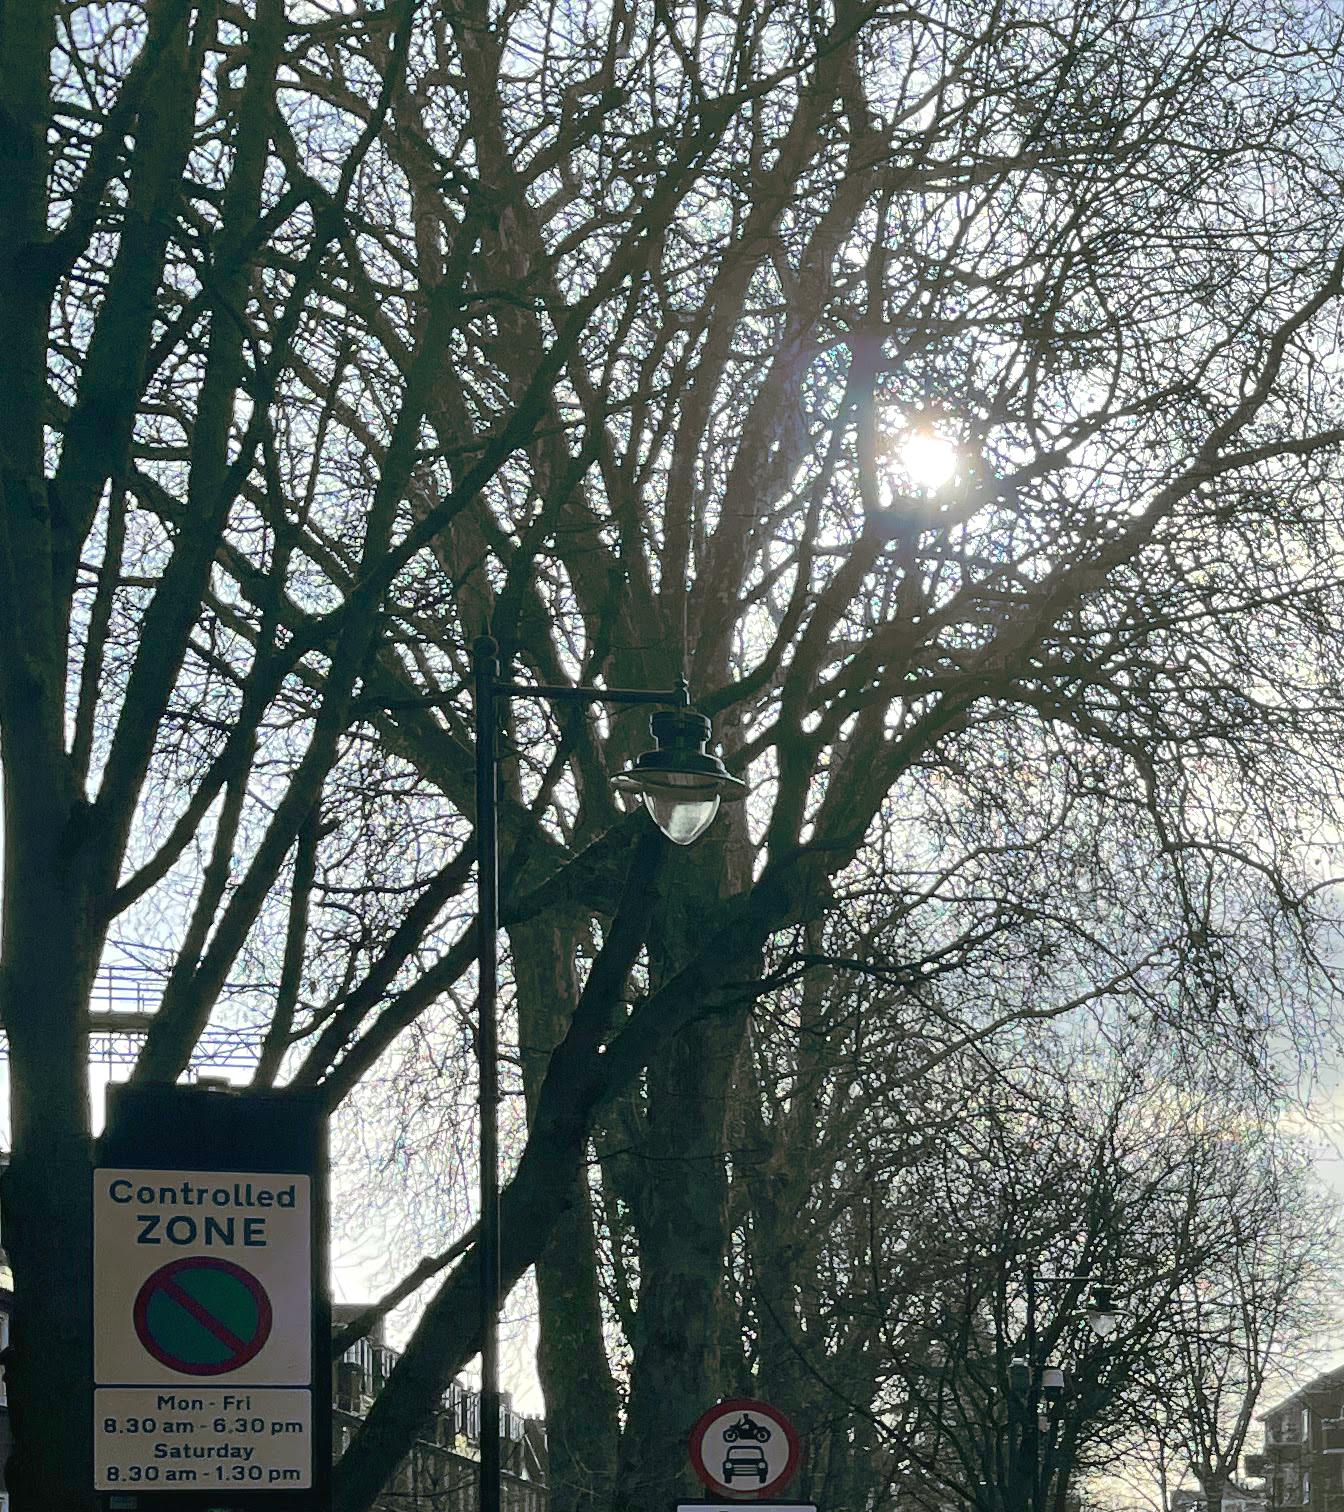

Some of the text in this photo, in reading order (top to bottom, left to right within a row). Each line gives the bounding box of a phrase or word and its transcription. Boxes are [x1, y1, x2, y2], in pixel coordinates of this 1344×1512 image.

[109, 1179, 296, 1208] Controlled
[137, 1215, 267, 1246] ZONE
[157, 1395, 203, 1411] Mon
[223, 1395, 251, 1411] Fri
[103, 1418, 156, 1434] 8.30
[162, 1421, 194, 1434] am
[213, 1418, 265, 1434] 6.30
[271, 1421, 303, 1436] pm
[154, 1443, 254, 1461] Saturday
[106, 1466, 160, 1482] 8.30
[165, 1468, 197, 1482] am
[215, 1465, 263, 1482] 1.30
[268, 1468, 301, 1483] pm
